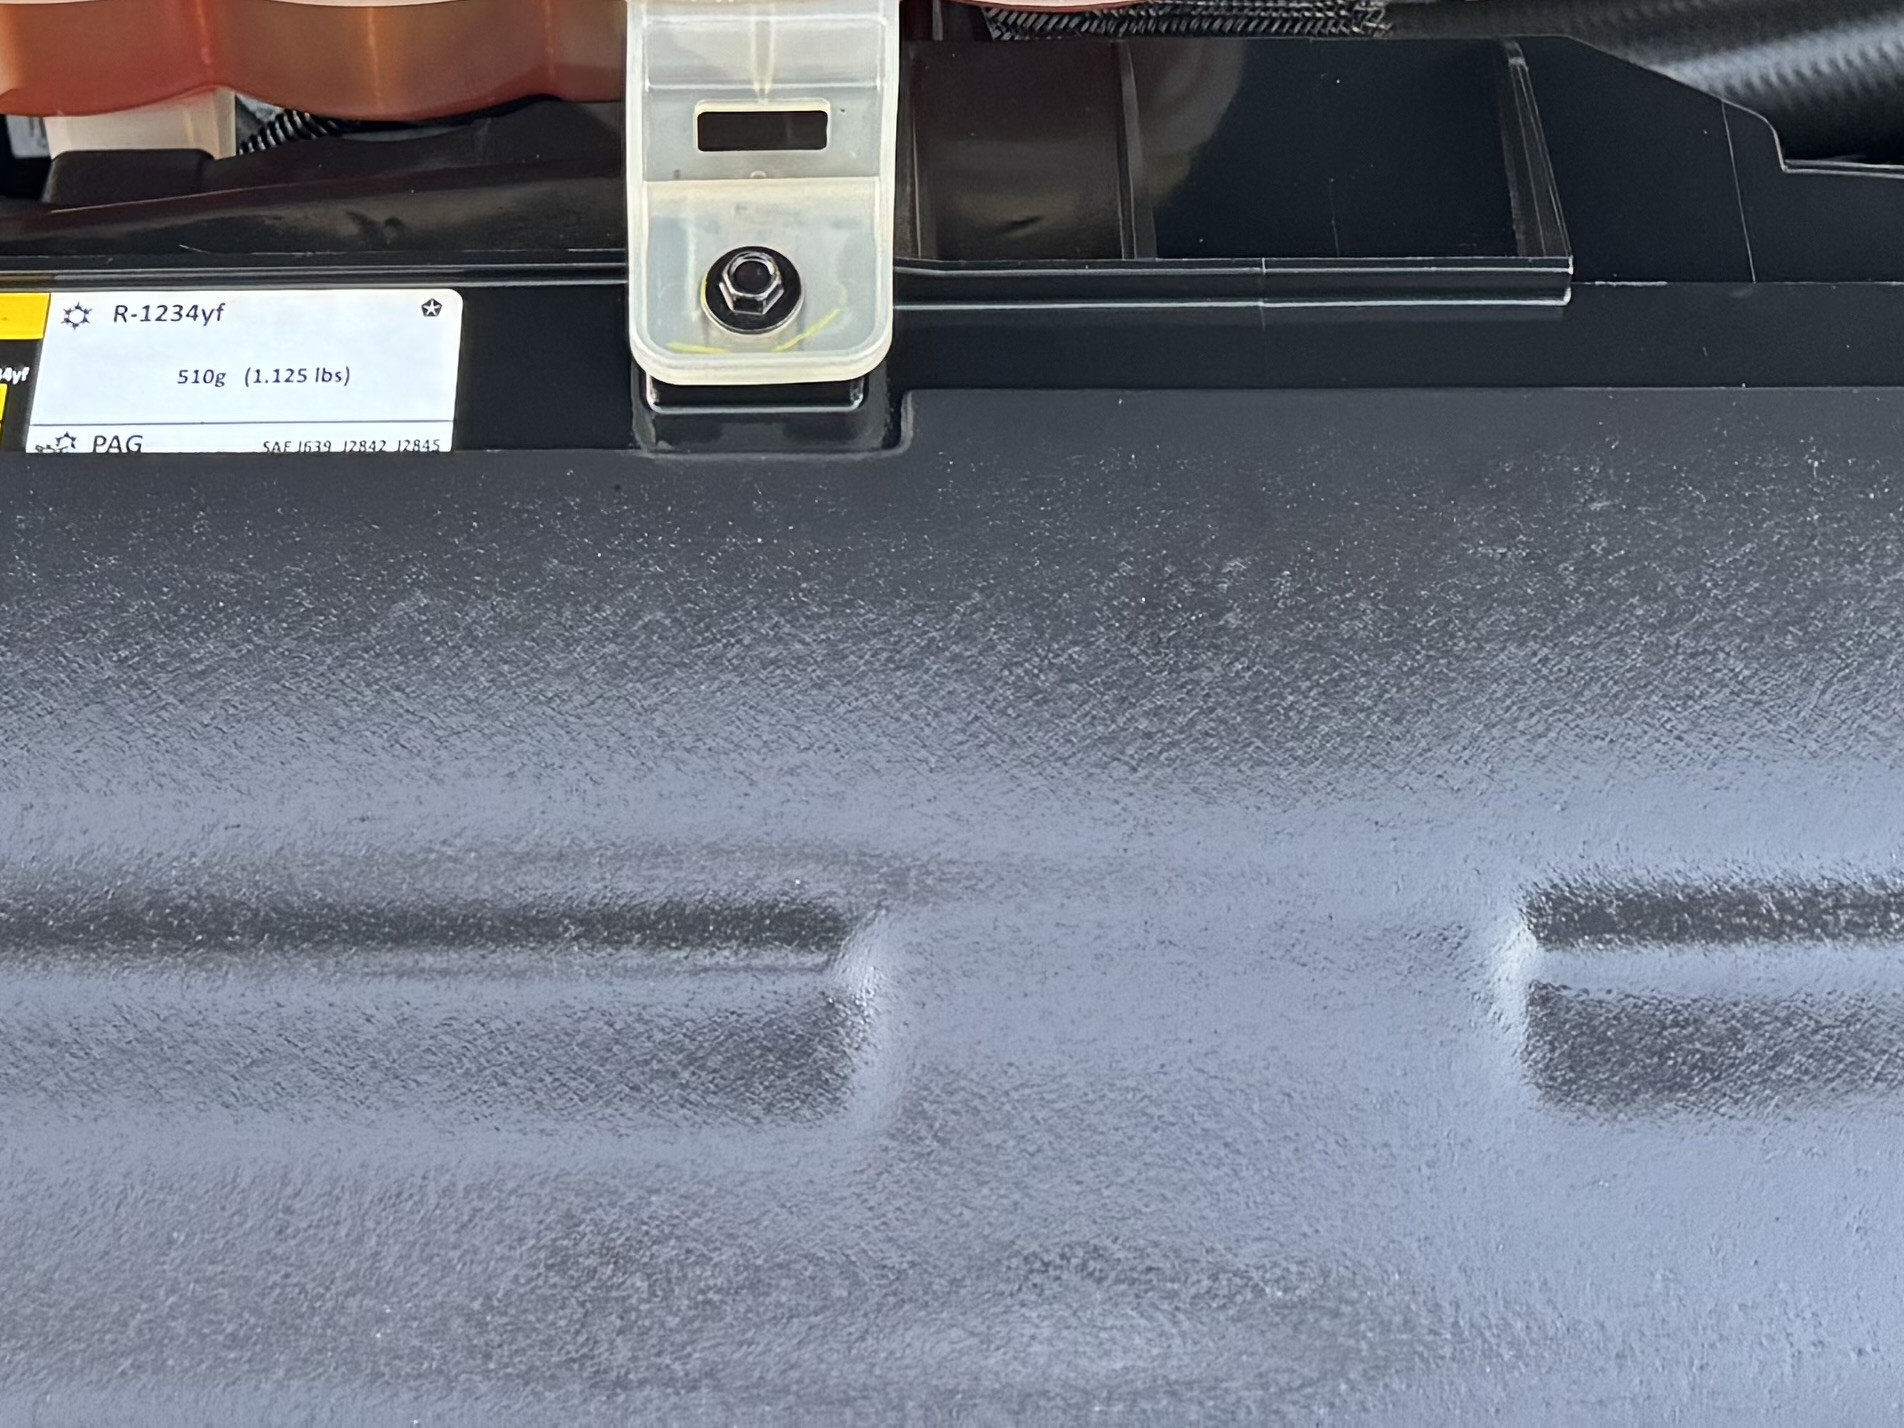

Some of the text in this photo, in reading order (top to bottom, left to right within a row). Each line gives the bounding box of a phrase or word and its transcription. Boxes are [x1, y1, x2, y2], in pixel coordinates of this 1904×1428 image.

[112, 302, 227, 325] R-1234yf
[177, 365, 351, 388] 510g (1.125 lbs)
[92, 434, 144, 453] PAG
